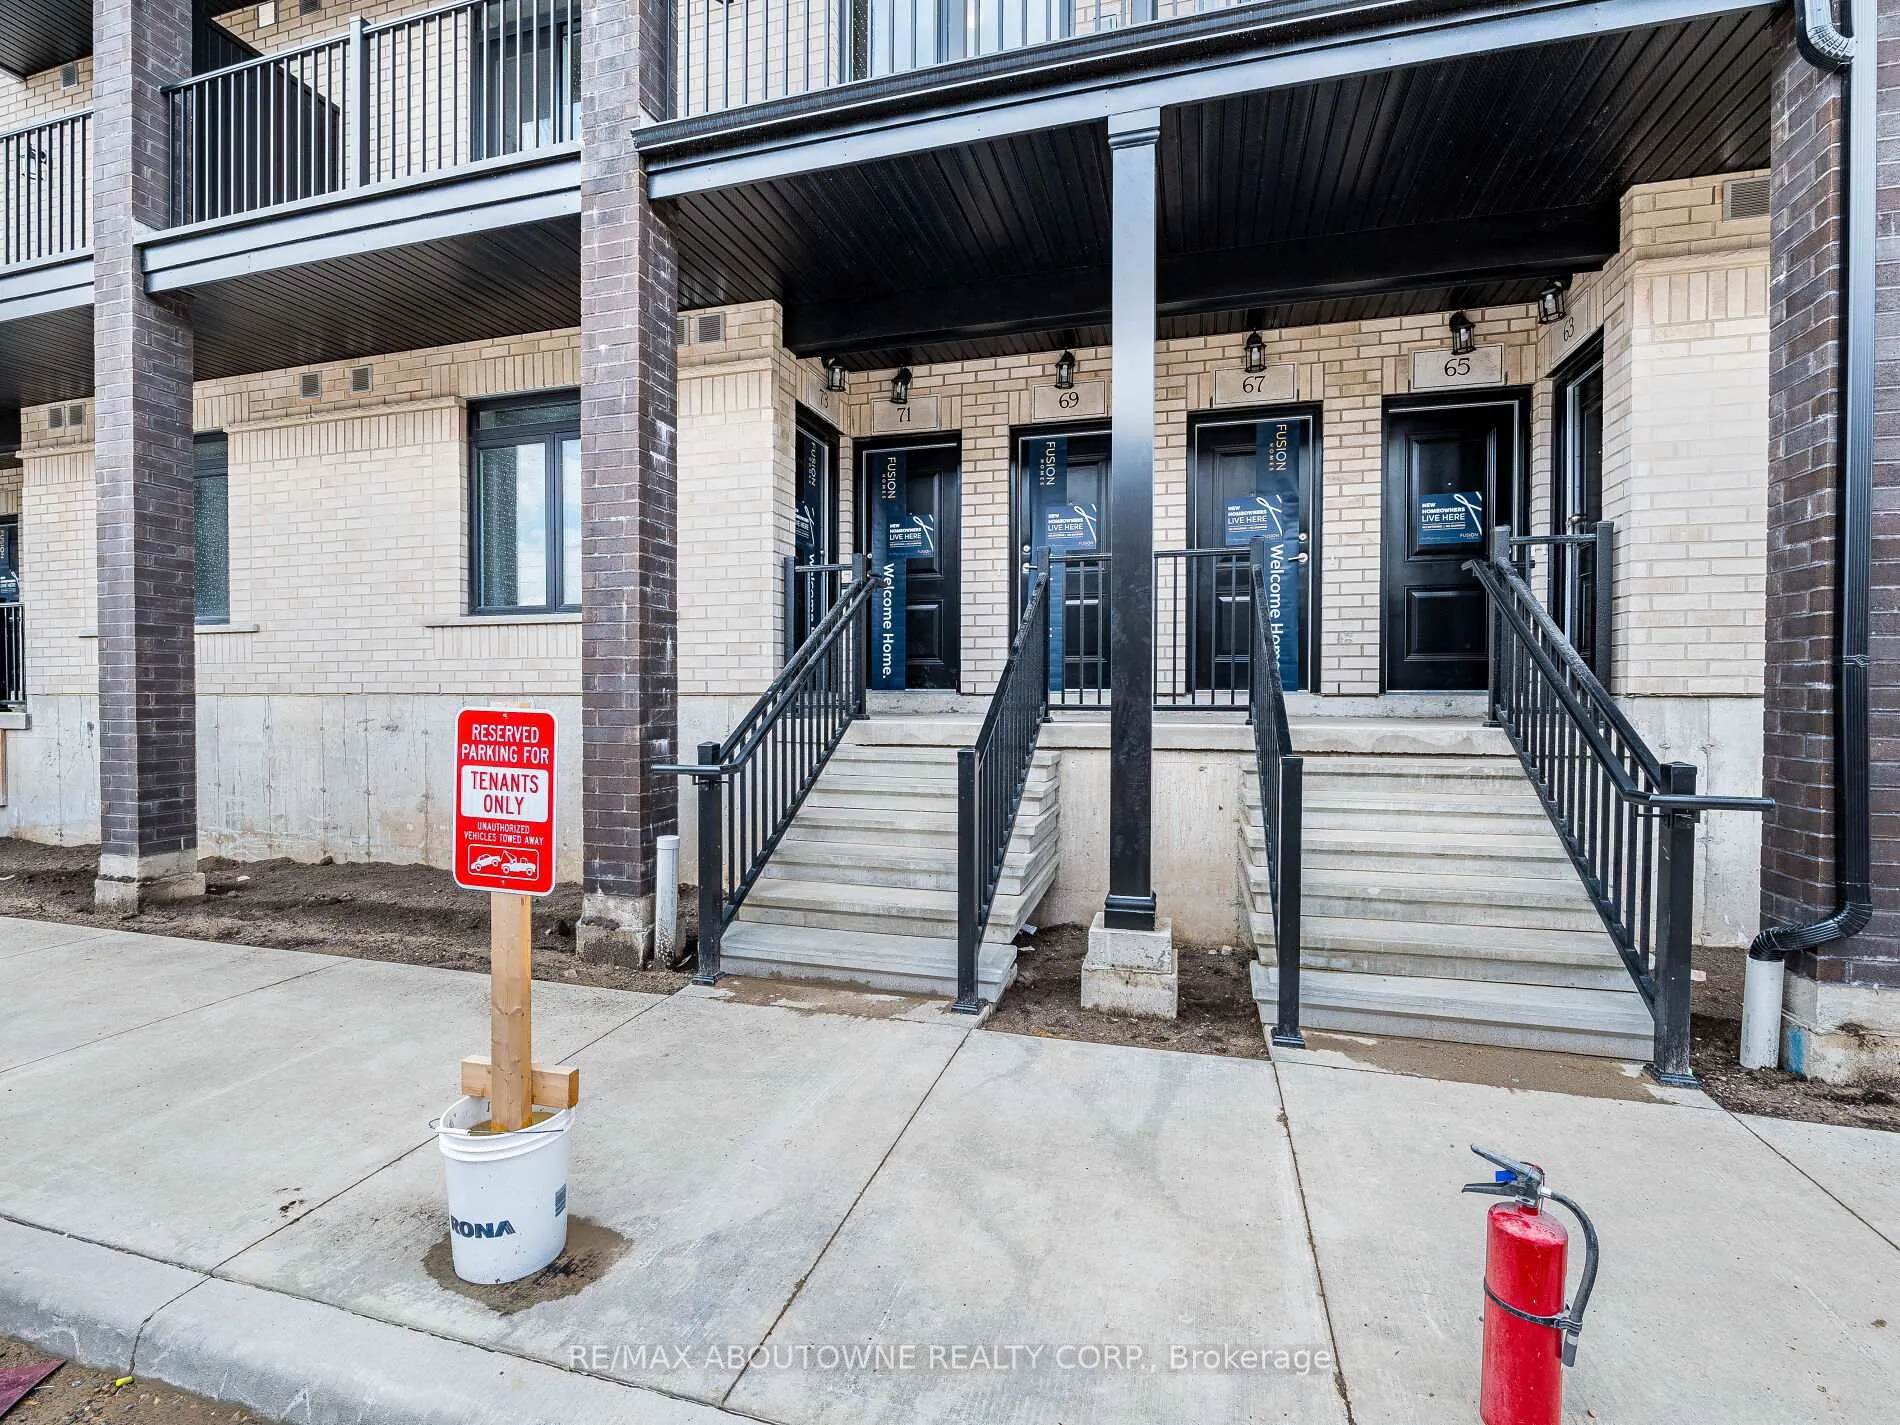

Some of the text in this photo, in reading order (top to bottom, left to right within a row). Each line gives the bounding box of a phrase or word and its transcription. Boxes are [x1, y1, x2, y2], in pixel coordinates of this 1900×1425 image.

[1563, 316, 1575, 342] 63
[1444, 357, 1471, 377] 65
[1242, 375, 1266, 393] 67
[819, 388, 829, 409] 73
[1058, 391, 1080, 409] 69
[897, 406, 911, 422] 71
[1276, 424, 1287, 471] FUSION
[1046, 441, 1056, 486] FUSION
[887, 457, 896, 499] FUSION
[1228, 515, 1267, 524] LIVE HERE
[1422, 513, 1465, 522] LIVE HERE
[904, 532, 921, 540] HERE
[1270, 543, 1284, 619] Welcome
[882, 562, 895, 679] Welcome Home.
[471, 723, 540, 744] RESERVED
[461, 743, 549, 765] PARKING FOR
[470, 770, 540, 794] TENANTS
[483, 793, 525, 816] ONLY
[464, 830, 544, 846] VEHICLES TOWED AWAY
[477, 821, 530, 834] UNAUTHORIZED
[450, 1215, 516, 1239] RONA
